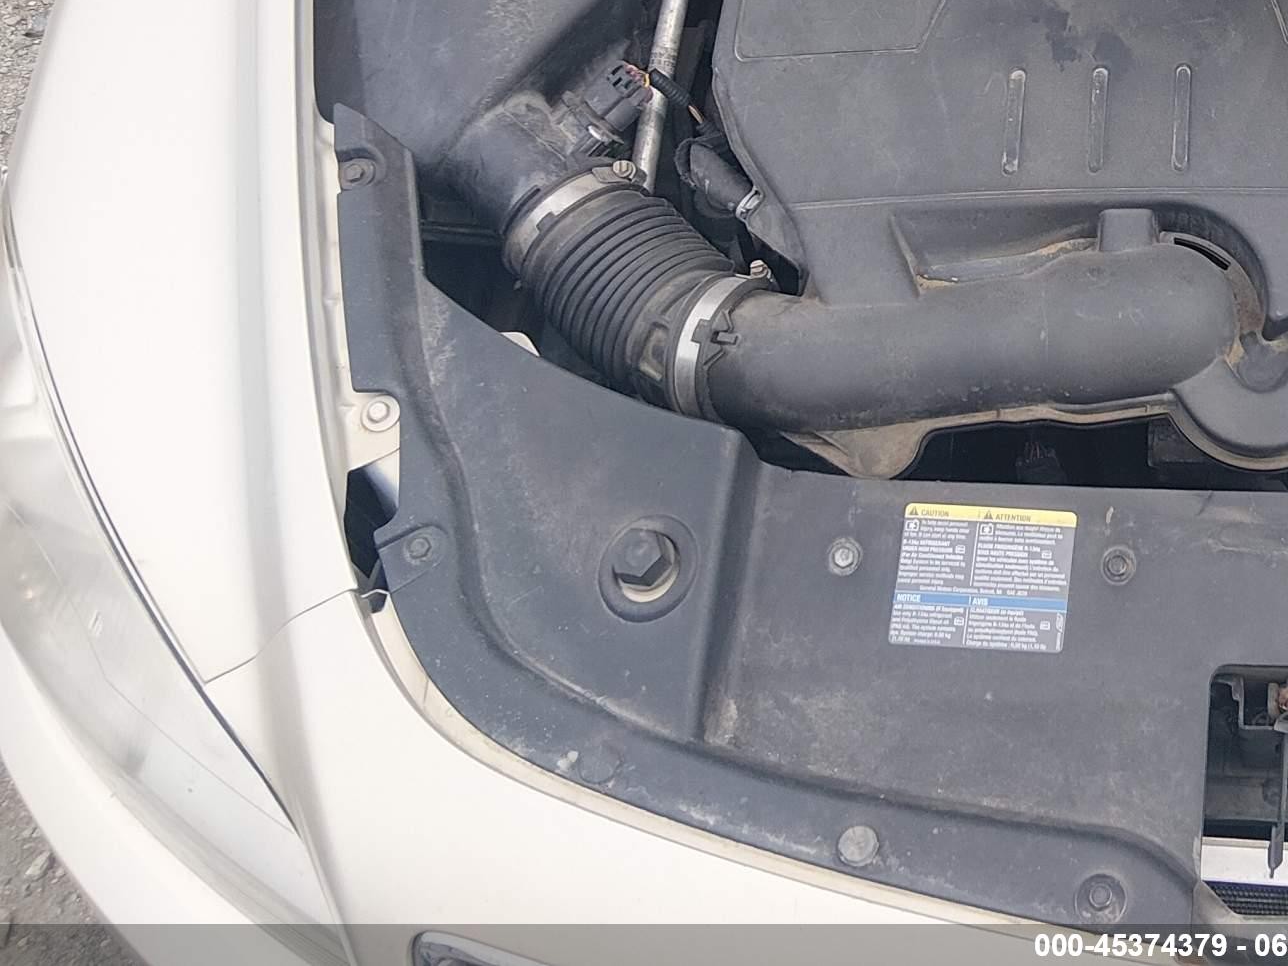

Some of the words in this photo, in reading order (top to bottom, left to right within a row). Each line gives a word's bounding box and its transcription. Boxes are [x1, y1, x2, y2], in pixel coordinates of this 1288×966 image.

[921, 509, 949, 518] CAUTION
[995, 513, 1031, 522] ATTENTION
[896, 593, 921, 603] NOTICE
[972, 597, 988, 606] AVIS
